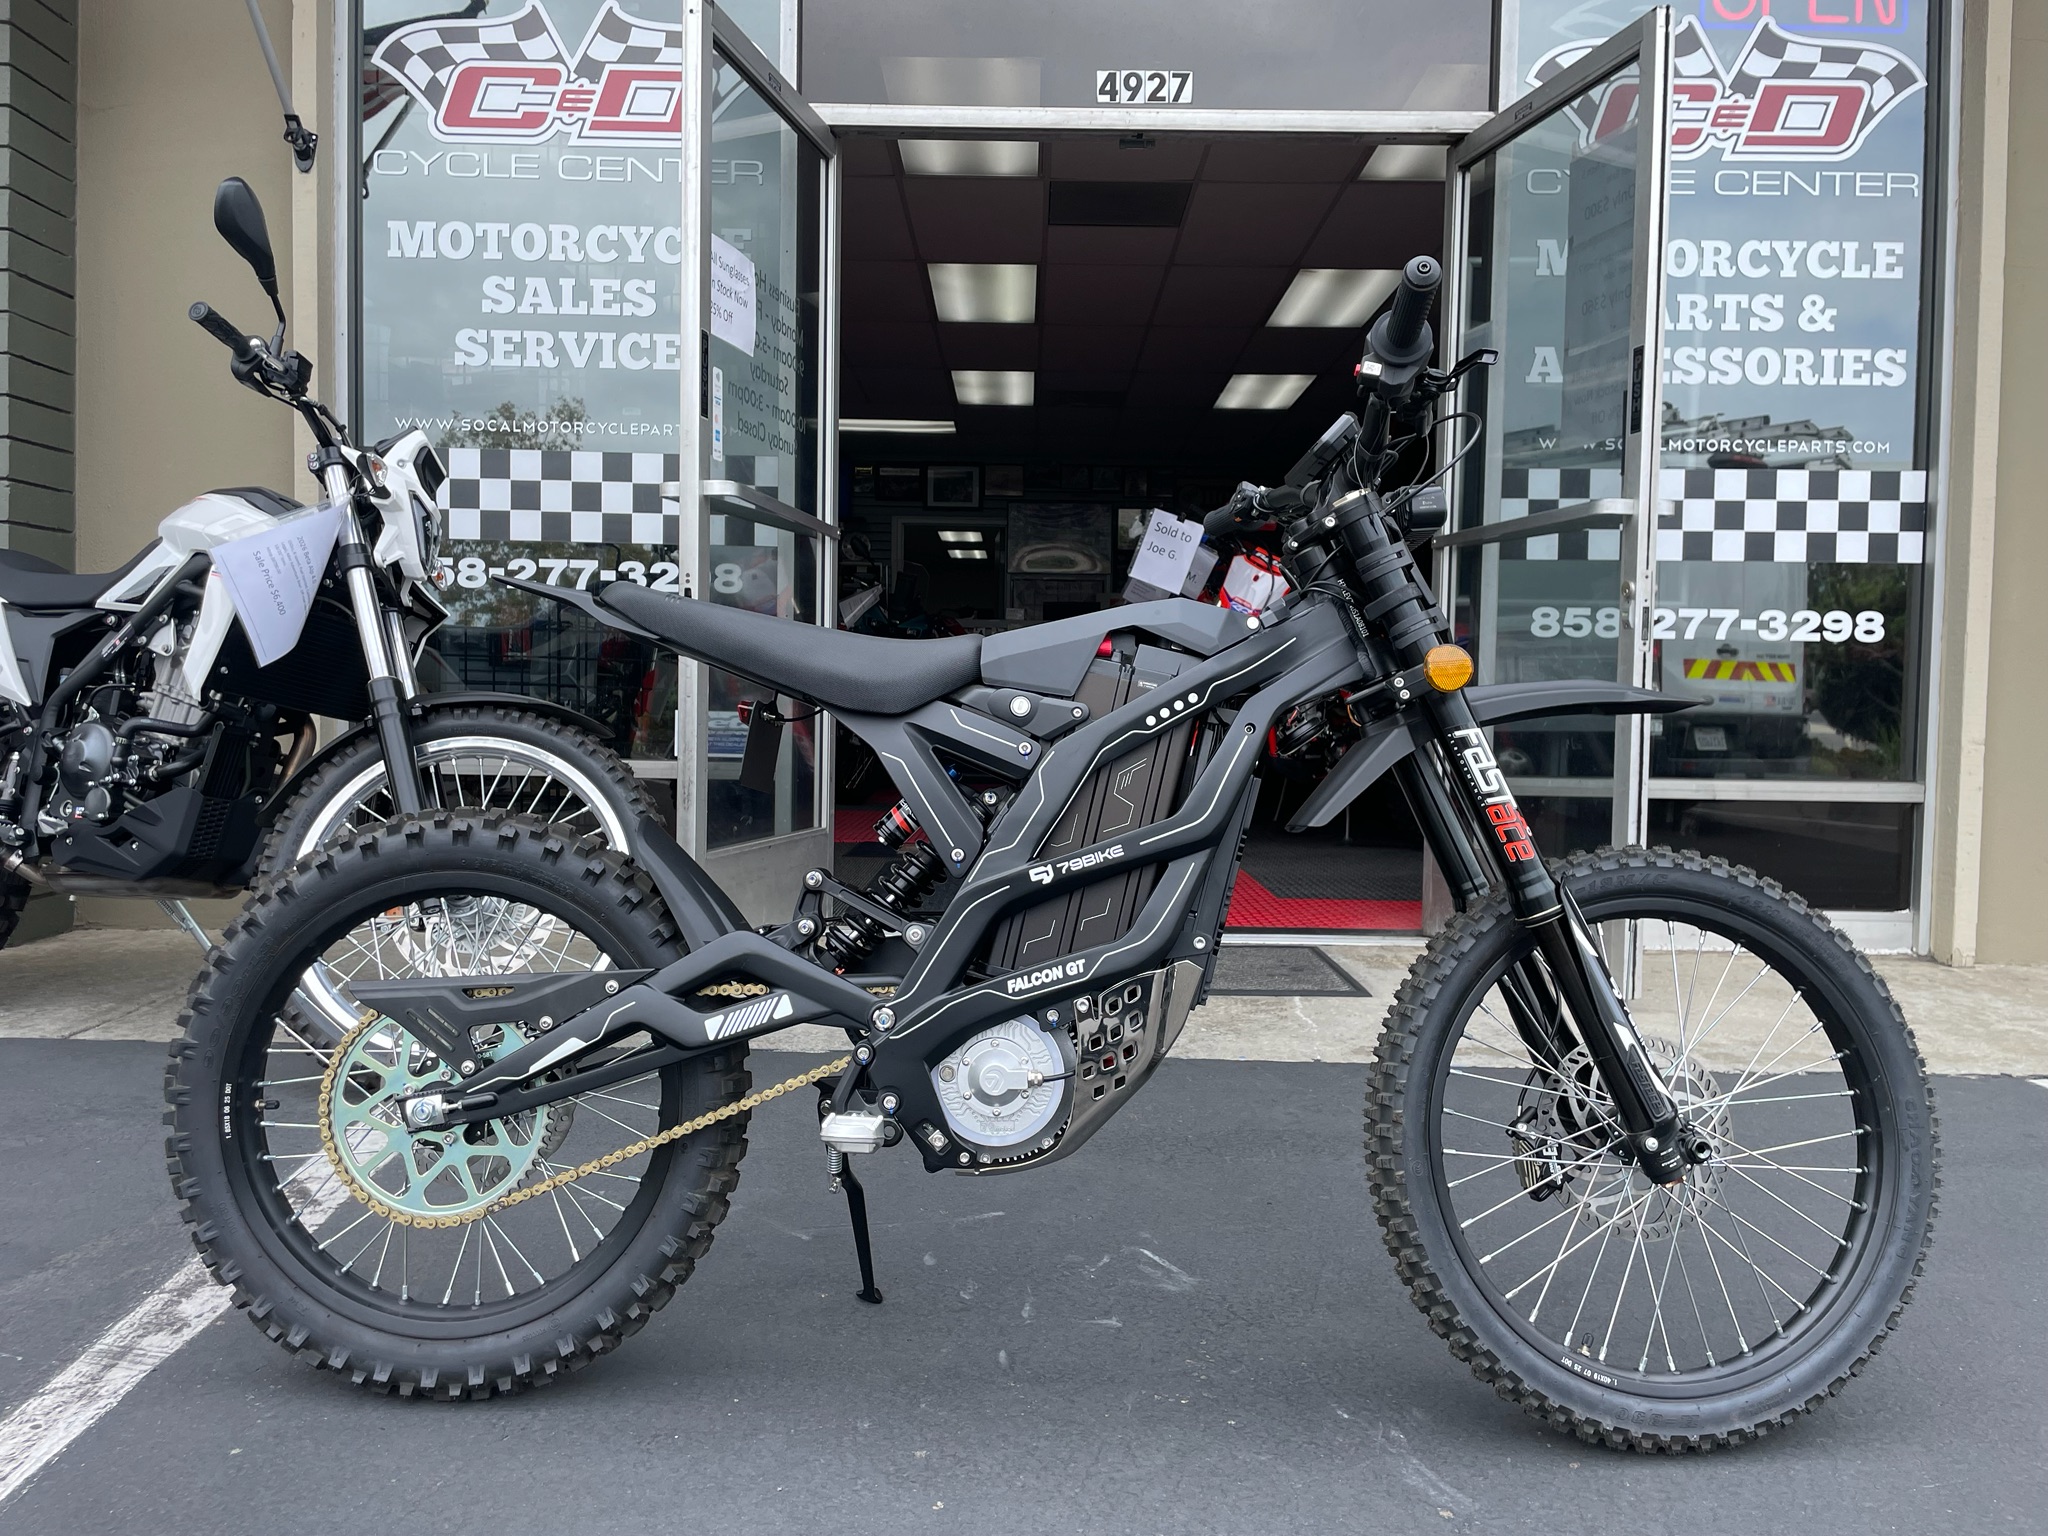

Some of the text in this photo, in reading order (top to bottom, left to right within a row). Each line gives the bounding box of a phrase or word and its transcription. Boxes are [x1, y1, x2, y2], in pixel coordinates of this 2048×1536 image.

[1098, 71, 1191, 103] 4927
[373, 150, 541, 180] CYCLE
[1714, 170, 1920, 197] CENTER
[387, 220, 752, 265] MOTORCYCE
[718, 256, 750, 287] Sunglasses
[1535, 239, 1905, 279] MORCYCLE
[481, 276, 656, 317] SALES
[717, 280, 733, 300] Stock
[734, 291, 749, 309] Now
[723, 309, 733, 325] Off
[1664, 293, 1838, 332] RTS &
[454, 328, 681, 370] SERVICE
[1525, 346, 1908, 387] ASSORIES
[1154, 521, 1193, 543] Sold to
[1147, 541, 1177, 561] Joe G.
[253, 550, 265, 569] Sale
[261, 568, 275, 589] Price
[270, 587, 287, 616] $6,400
[1530, 606, 1885, 643] 858277-3298
[1056, 844, 1125, 874] 79BIKE
[1007, 958, 1086, 994] FALCON GT
[224, 1082, 233, 1094] DOT
[1560, 1356, 1573, 1368] DOT
